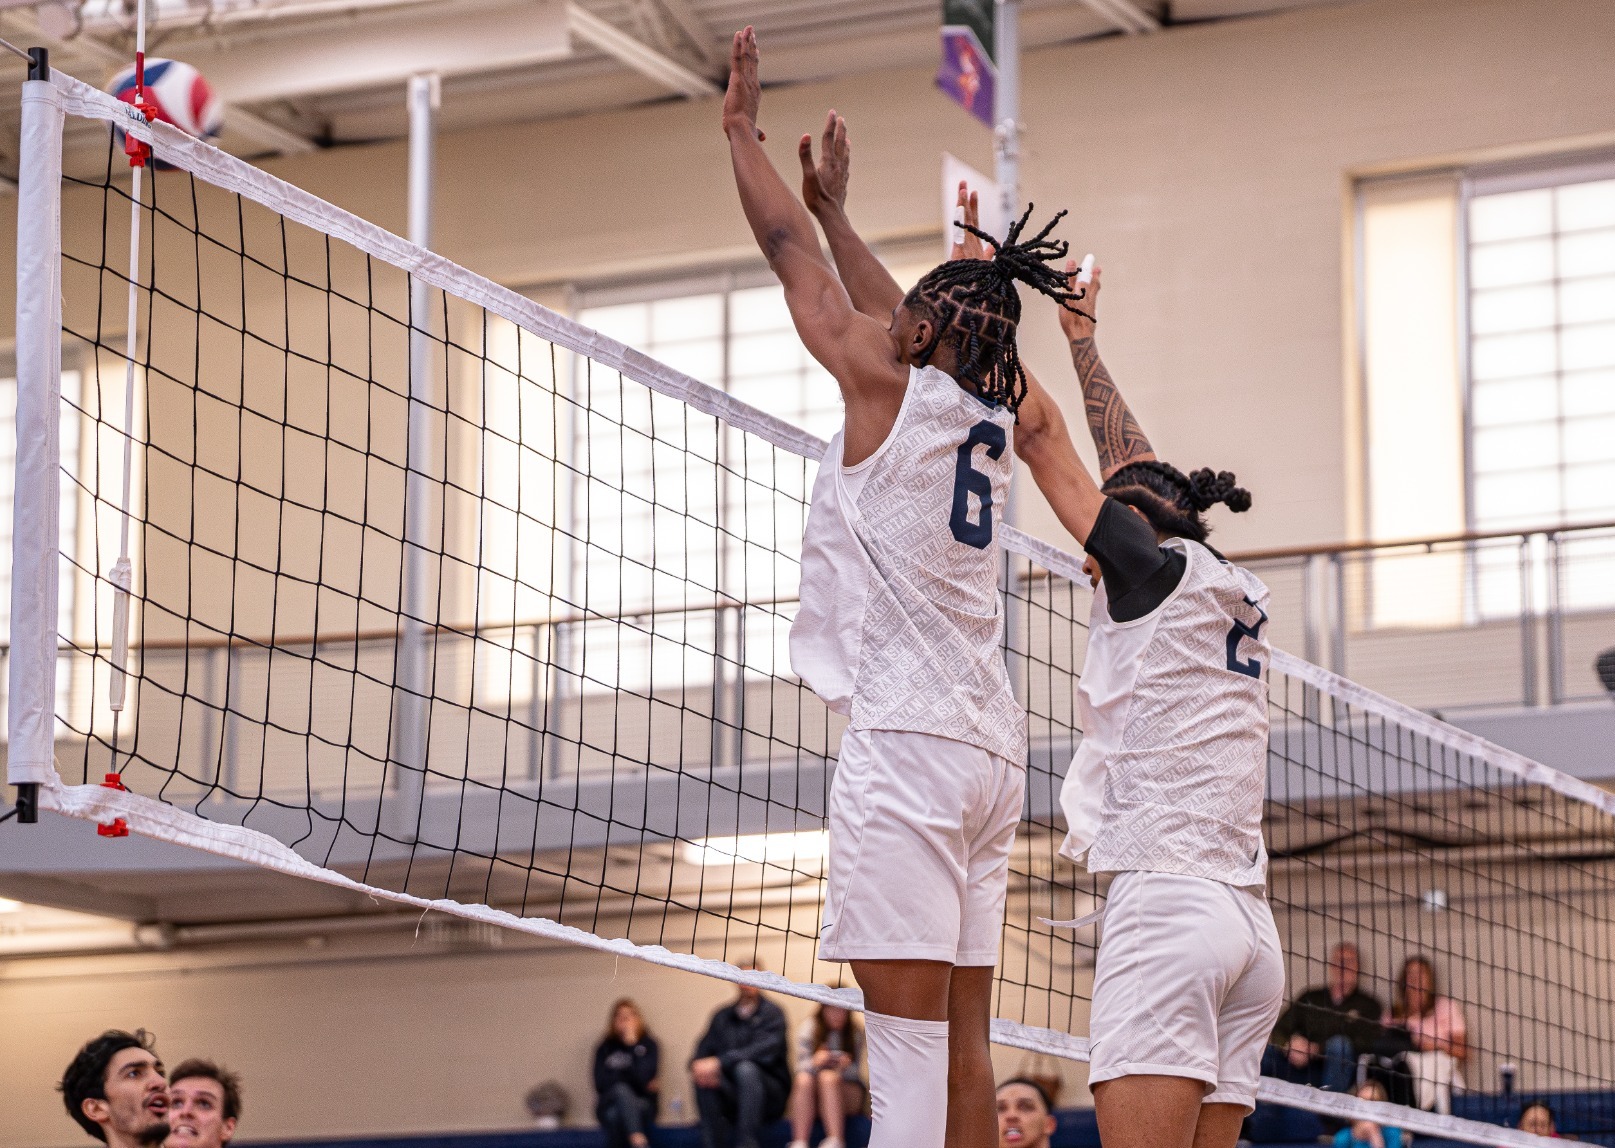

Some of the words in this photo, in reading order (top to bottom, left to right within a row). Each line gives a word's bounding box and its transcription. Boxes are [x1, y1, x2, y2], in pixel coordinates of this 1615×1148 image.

[890, 420, 939, 461] SPARTAN
[919, 485, 952, 511] SPAR
[949, 419, 1007, 550] 6
[866, 492, 906, 520] ARTAN
[887, 629, 915, 659] SPAR
[936, 634, 963, 662] SPAR
[1226, 594, 1267, 679] 2
[900, 643, 926, 671] SPAR
[949, 649, 976, 677] SPAR
[911, 659, 941, 688] SPAR
[862, 682, 912, 726] SPARTAN
[1175, 681, 1218, 721] SPARTAN
[1133, 718, 1176, 750] PARTAN
[1158, 750, 1205, 786] SPARTAN
[1206, 799, 1230, 815] RTAN
[1141, 813, 1187, 846] SPARTAN
[1152, 826, 1197, 861] SPARTAN
